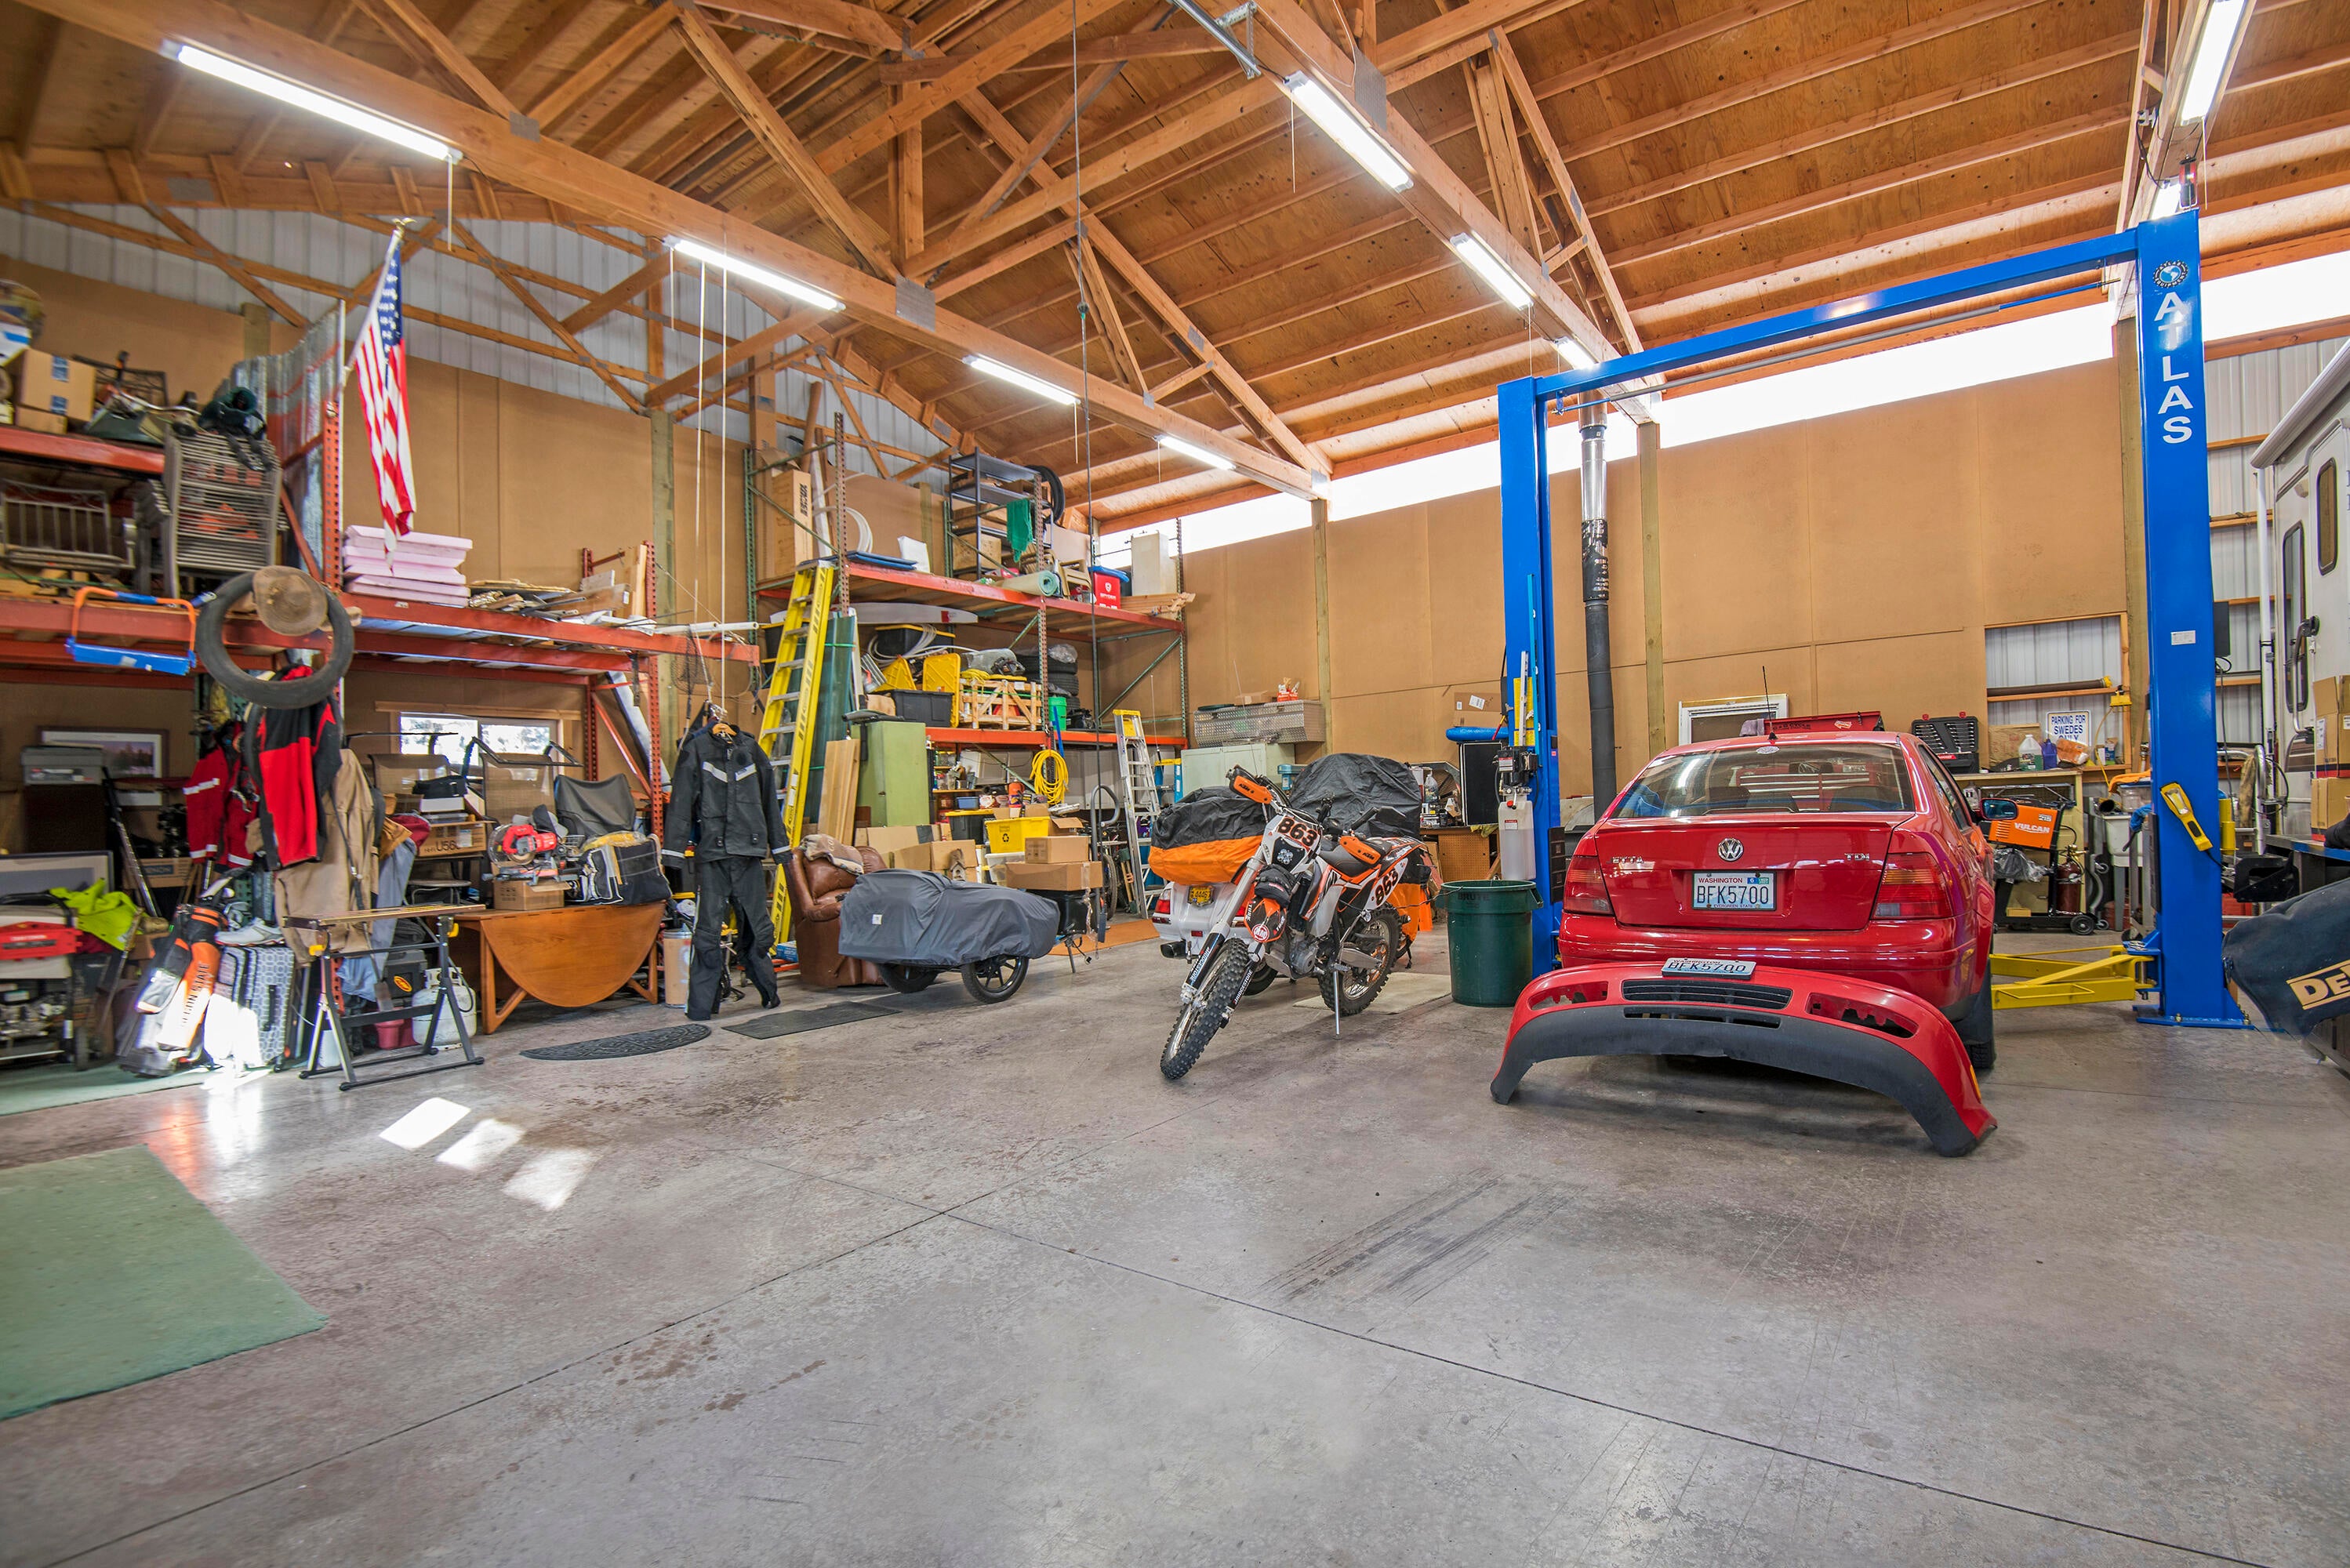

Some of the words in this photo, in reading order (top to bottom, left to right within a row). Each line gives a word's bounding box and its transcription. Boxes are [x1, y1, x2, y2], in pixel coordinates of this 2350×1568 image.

[2154, 291, 2194, 444] ATLAS
[2050, 715, 2073, 724] PARKING
[2075, 714, 2086, 724] FOR
[2054, 724, 2083, 735] SWEDES
[1238, 782, 1251, 793] KTM
[1277, 817, 1318, 848] 863
[2014, 822, 2050, 833] VULCAN
[1361, 851, 1375, 861] KTM
[1844, 852, 1870, 861] TDI
[1375, 869, 1399, 907] 863
[1458, 891, 1490, 901] BRUTE
[1697, 885, 1769, 905] BFK5700
[1667, 961, 1747, 972] BFK5700
[1234, 969, 1254, 1004] BRIDGESTONE
[2290, 964, 2350, 1007] DE
